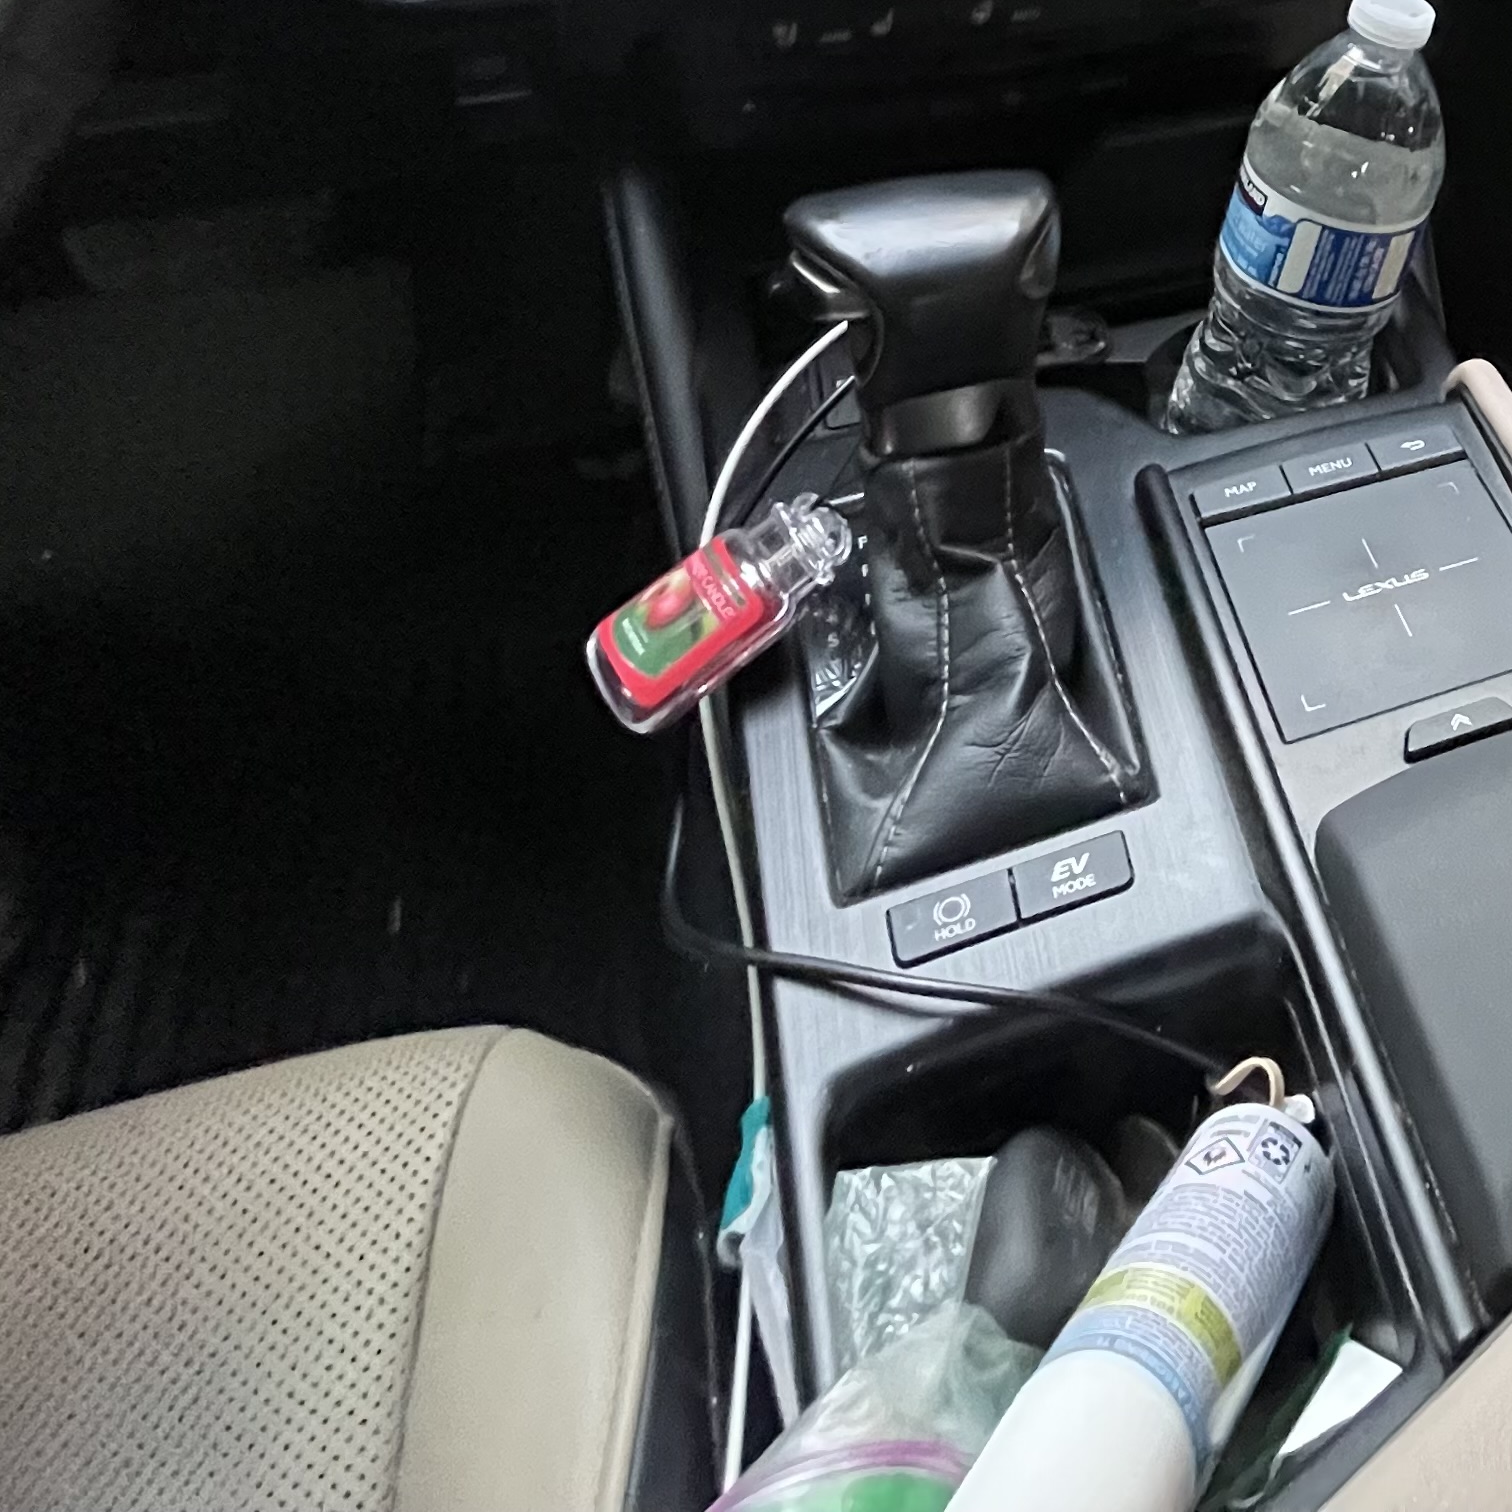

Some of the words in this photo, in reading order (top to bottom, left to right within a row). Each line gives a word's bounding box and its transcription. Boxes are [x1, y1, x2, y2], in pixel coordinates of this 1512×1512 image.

[1308, 457, 1353, 477] MENU
[1223, 479, 1258, 498] MAP
[1341, 568, 1431, 602] LEXUS
[1050, 852, 1090, 882] EV
[1051, 873, 1097, 899] MODE
[933, 918, 977, 942] HOLD
